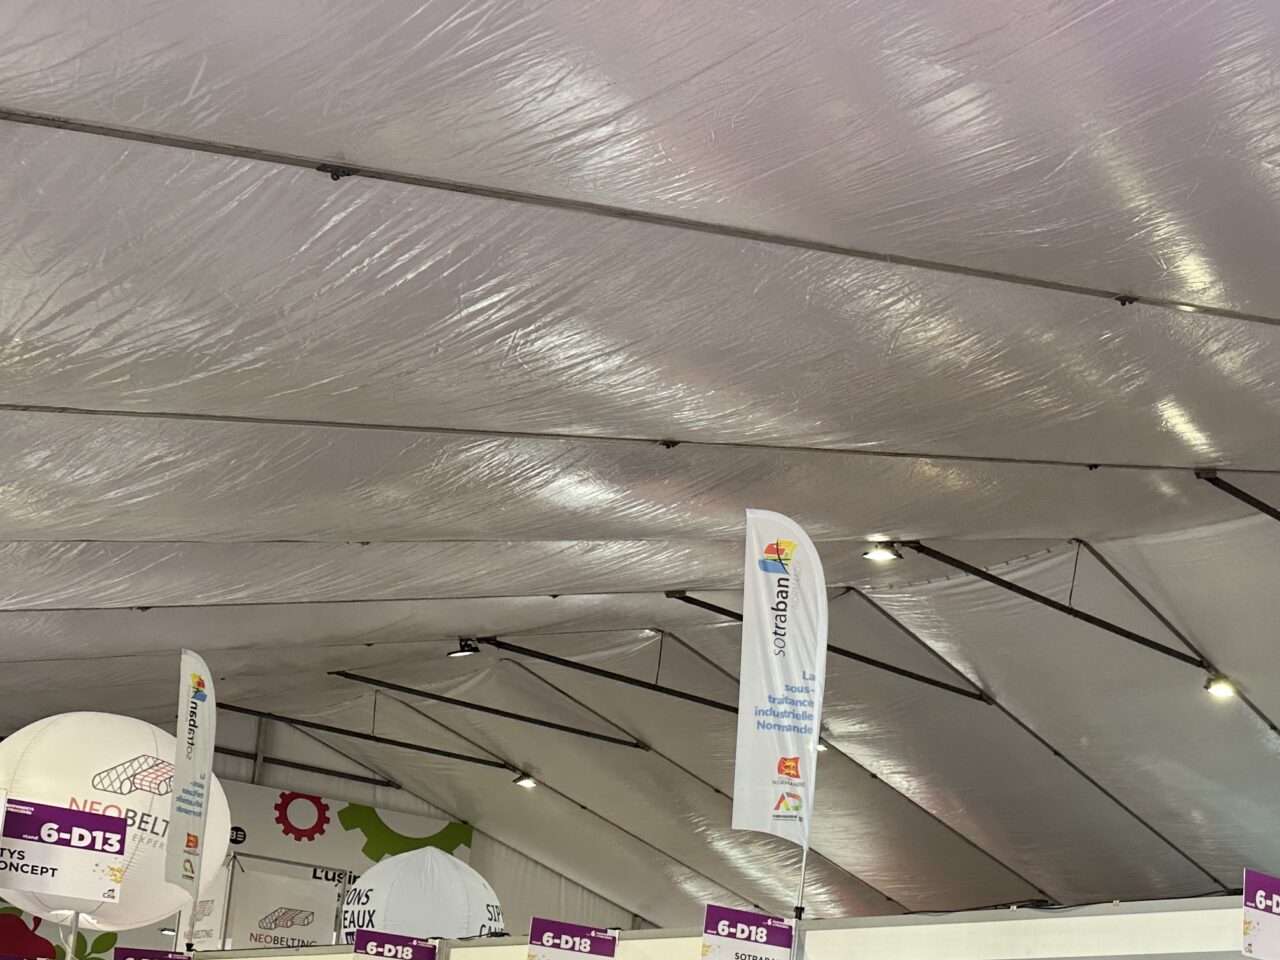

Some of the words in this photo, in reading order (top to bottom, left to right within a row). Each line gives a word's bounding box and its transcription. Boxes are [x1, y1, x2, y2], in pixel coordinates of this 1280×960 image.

[773, 575, 790, 657] sotraban
[802, 671, 816, 681] La
[784, 683, 815, 694] sous-
[754, 706, 814, 721] industrielle
[40, 822, 121, 854] 6-D13
[0, 848, 25, 860] TYS
[717, 919, 768, 943] 6-D18
[366, 941, 413, 960] 6-D18
[542, 932, 591, 953] 6-D18
